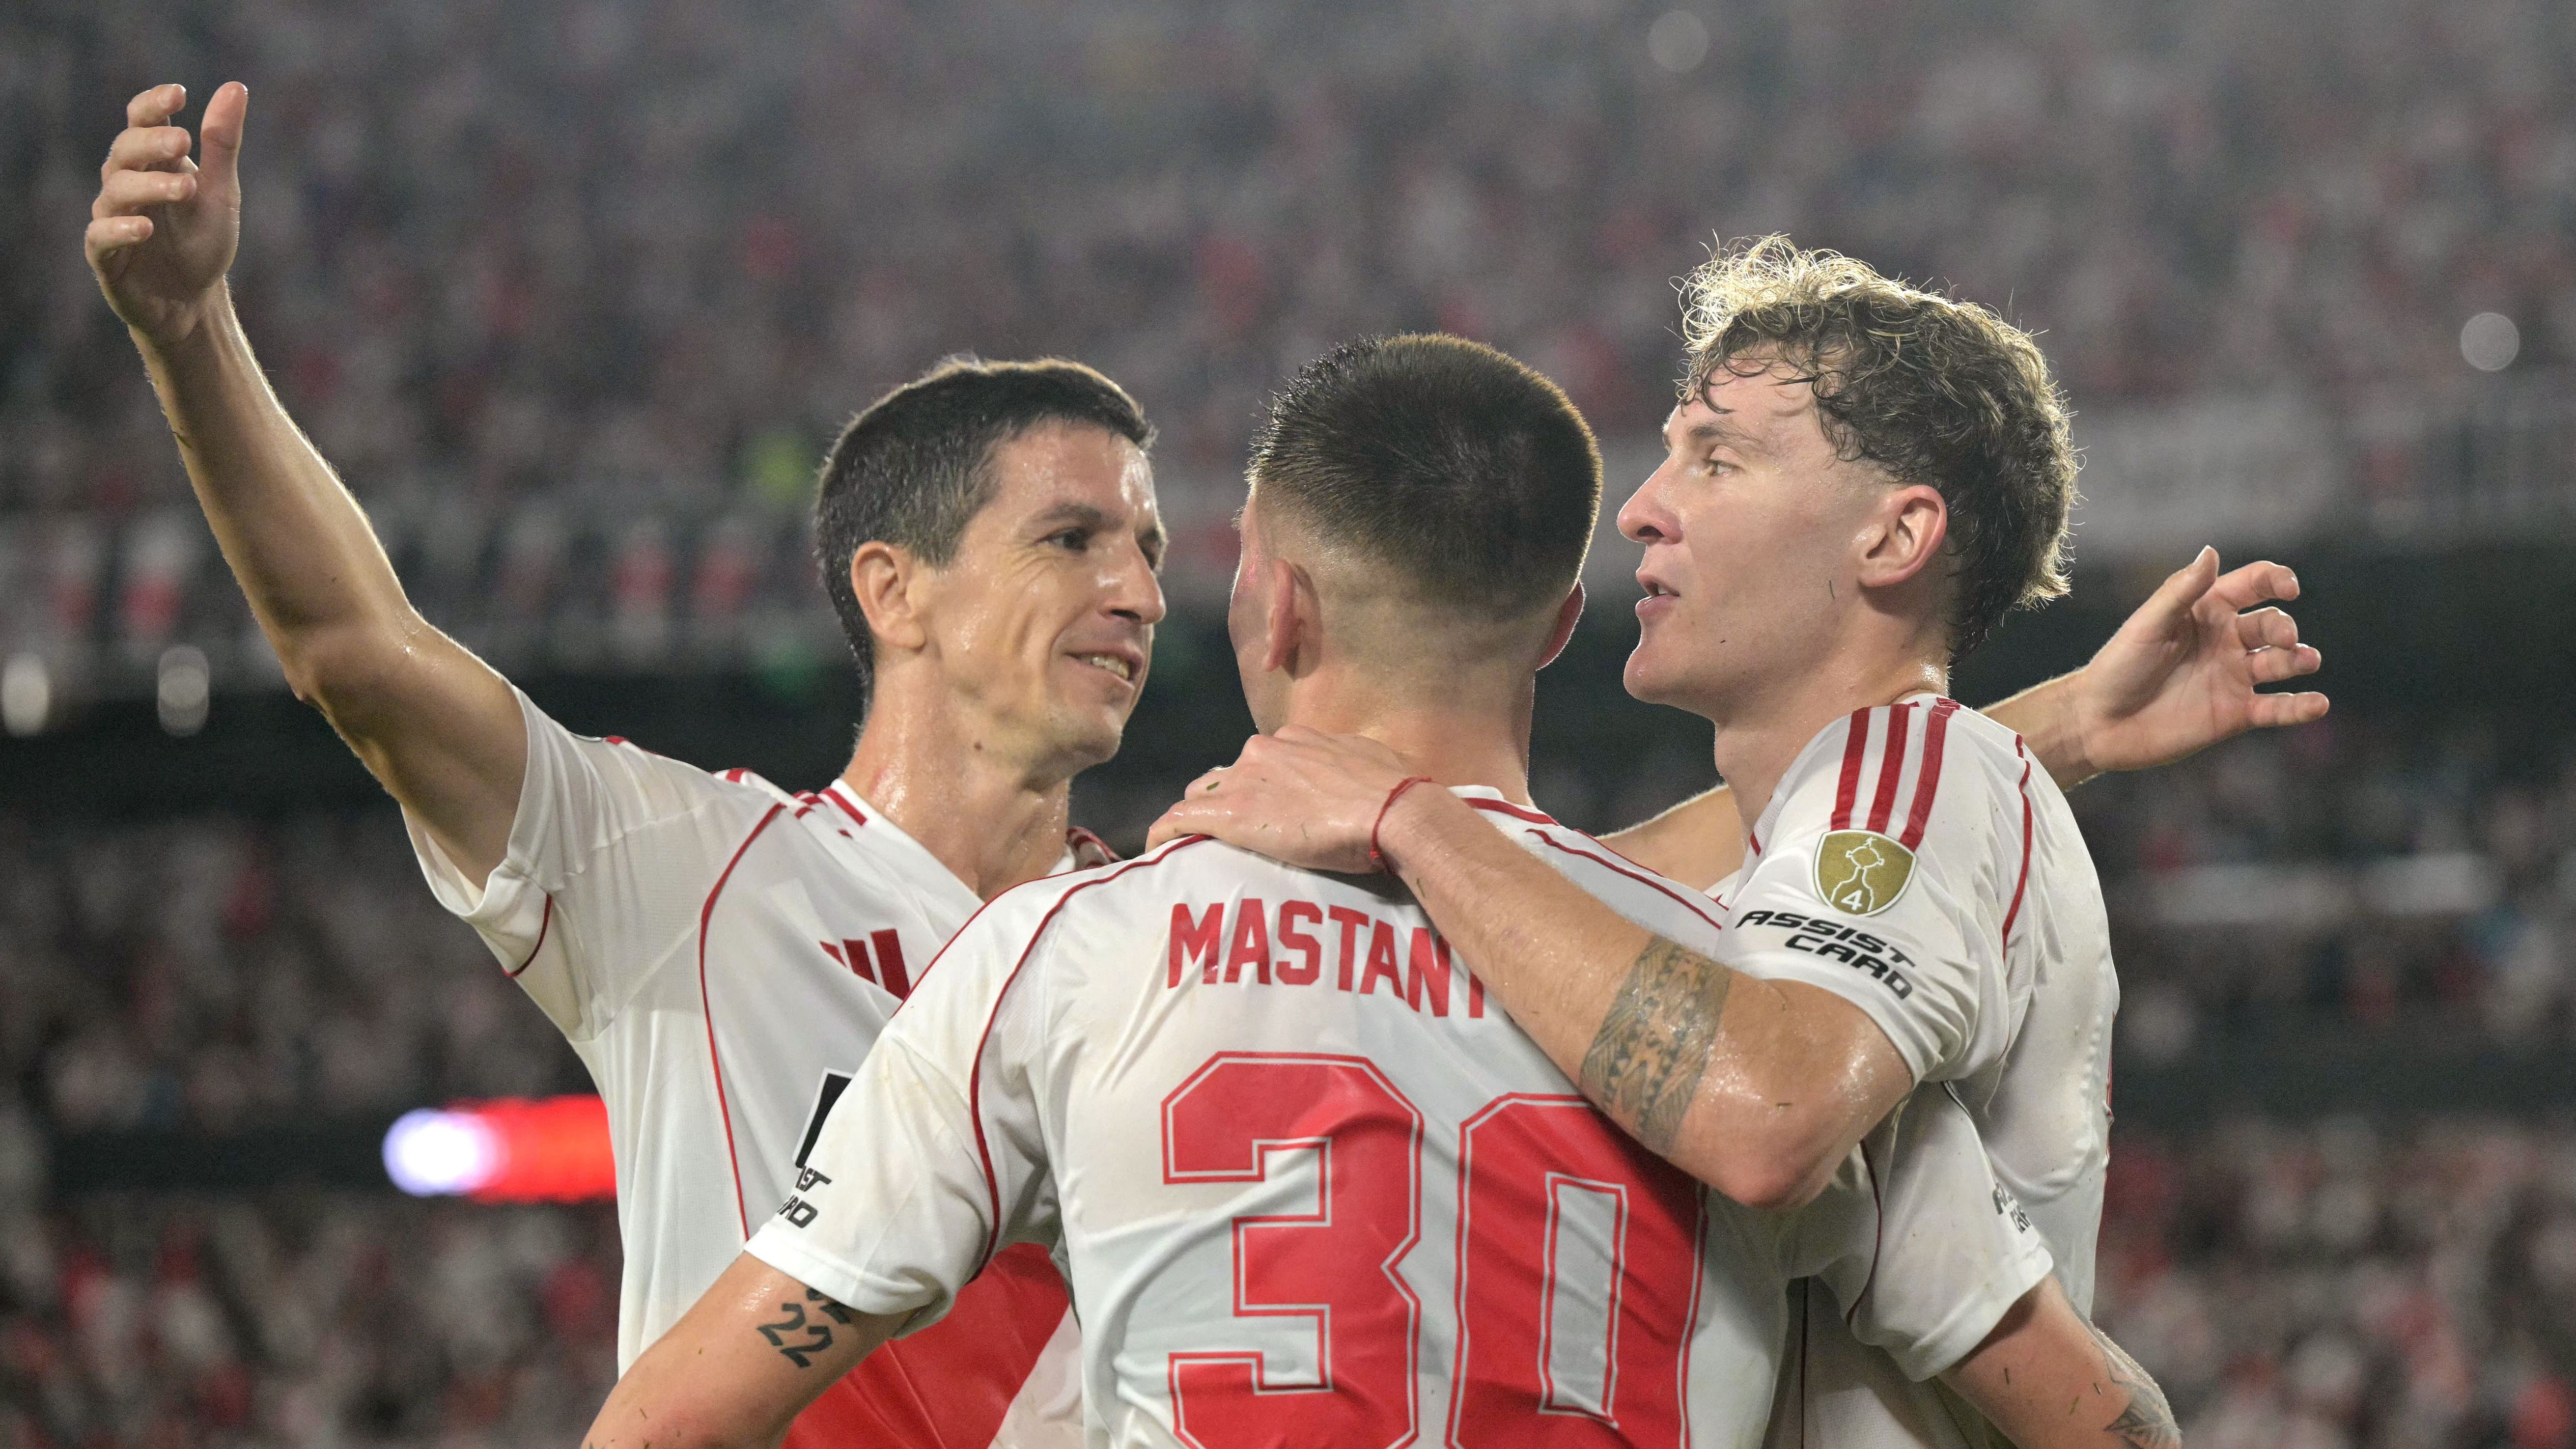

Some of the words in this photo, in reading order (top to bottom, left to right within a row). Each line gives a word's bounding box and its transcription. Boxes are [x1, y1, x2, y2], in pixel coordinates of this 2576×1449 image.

[1840, 889, 1863, 910] 4
[1735, 910, 1916, 968] ASSIST
[1784, 934, 1913, 1000] CARD
[1161, 1051, 1709, 1449] 30
[756, 1302, 833, 1368] 22
